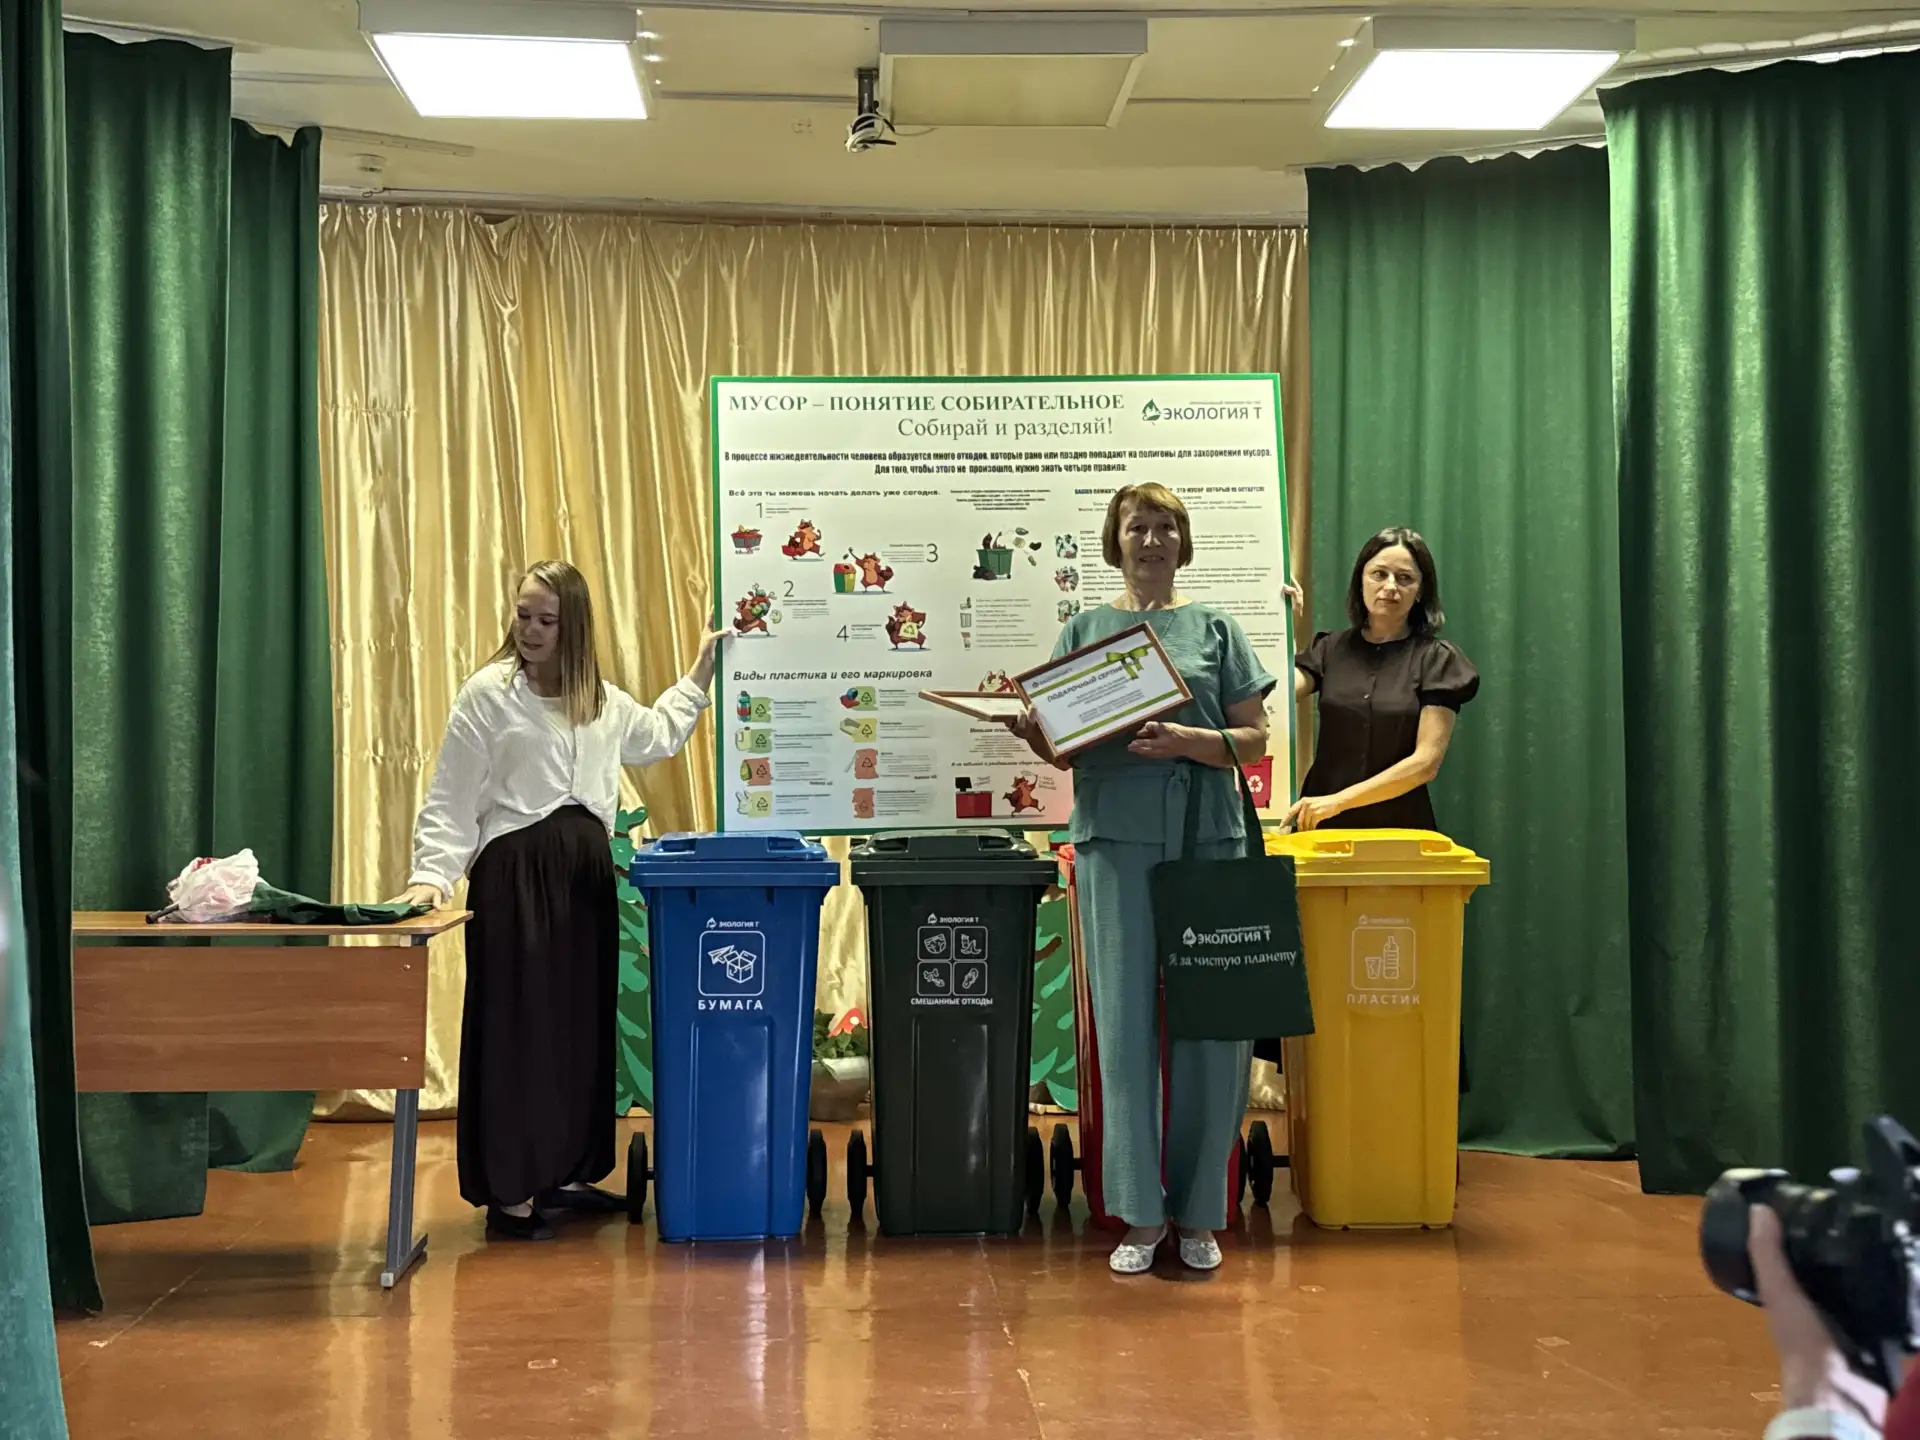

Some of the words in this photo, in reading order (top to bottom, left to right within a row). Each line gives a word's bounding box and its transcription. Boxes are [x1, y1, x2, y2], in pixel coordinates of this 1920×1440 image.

[729, 395, 808, 411] МУСОР
[830, 395, 936, 411] ПОНЯТИЕ
[941, 394, 1124, 411] СОБИРАТЕЛЬНОЕ
[1164, 406, 1249, 420] ЭКОЛОГИЯ
[1252, 406, 1262, 419] Т
[898, 418, 988, 440] Собирай
[996, 423, 1007, 436] и
[1014, 417, 1113, 440] разделяй!
[724, 452, 730, 461] В
[732, 452, 768, 462] процессе
[769, 452, 849, 462] жизнедеятельности
[851, 451, 887, 461] человека
[888, 451, 932, 462] образуется
[933, 451, 956, 460] много
[991, 450, 1023, 461] которые
[1024, 450, 1042, 461] рано
[1044, 450, 1058, 460] или
[1060, 450, 1088, 461] поздно
[1089, 450, 1127, 460] попадают
[1128, 450, 1137, 459] на
[1138, 450, 1176, 460] полигоны
[1178, 450, 1192, 460] для
[1194, 450, 1242, 459] захоронения
[874, 464, 890, 475] Для
[910, 464, 934, 474] чтобы
[936, 464, 956, 474] этого
[958, 464, 966, 474] не
[969, 464, 1014, 475] произошло,
[1016, 464, 1039, 474] нужно
[1041, 464, 1062, 474] знать
[1064, 463, 1092, 474] четыре
[1094, 463, 1128, 474] правила:
[756, 502, 764, 518] 1
[926, 543, 938, 563] 3
[783, 580, 794, 598] 2
[836, 624, 850, 642] 4
[733, 670, 766, 681] Виды
[770, 672, 828, 680] пластика
[830, 672, 838, 680] и
[840, 671, 860, 680] его
[864, 670, 932, 681] маркировка
[718, 920, 754, 928] ЭКОЛОГИЯ
[939, 916, 972, 924] ЭКОЛОГИЯ
[1198, 931, 1261, 945] ЭКОЛОГИЯ
[1264, 930, 1271, 942] Т
[1180, 956, 1192, 966] за
[1194, 954, 1241, 971] чистую
[1244, 950, 1297, 968] планету
[698, 1000, 764, 1011] БУМАГА
[910, 996, 960, 1006] СМЕШАННЫЕ
[962, 996, 993, 1006] ОТХОДЫ
[1346, 994, 1420, 1004] ПЛАСТИК
